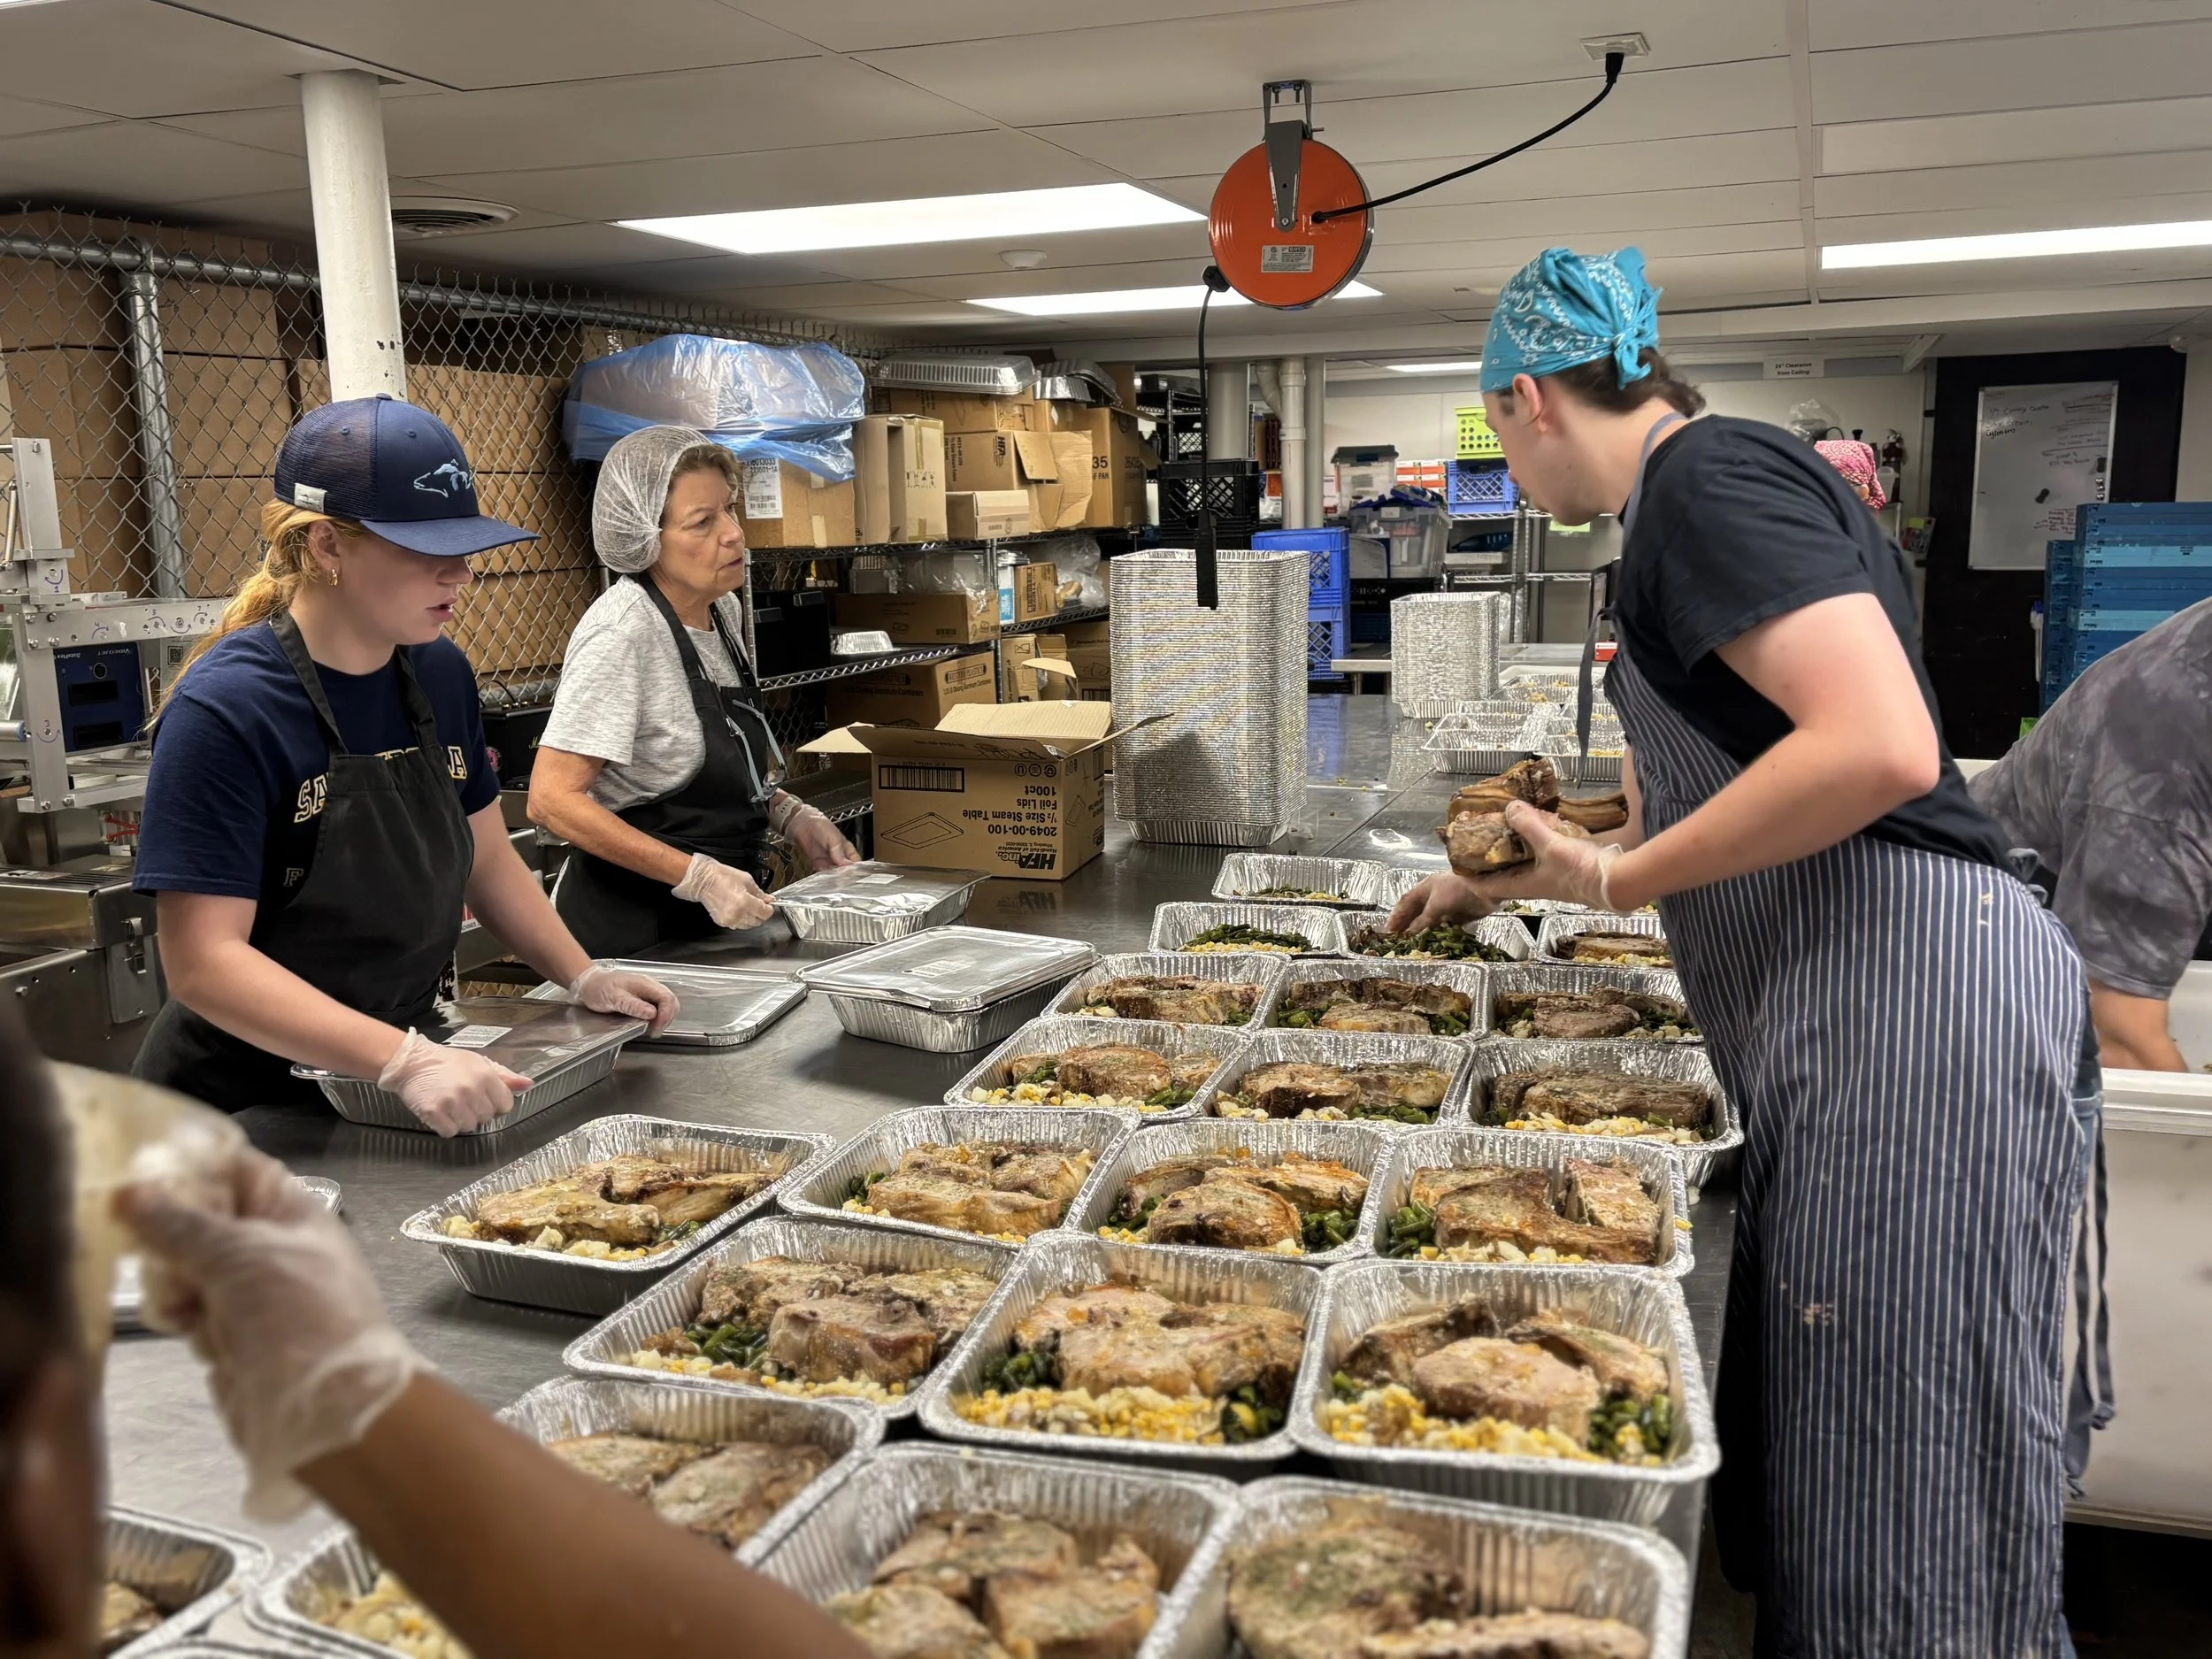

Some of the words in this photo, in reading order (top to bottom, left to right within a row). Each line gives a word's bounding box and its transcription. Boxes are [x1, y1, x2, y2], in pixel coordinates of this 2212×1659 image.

[997, 436, 1006, 456] HFA
[1025, 785, 1056, 797] 100ct
[1017, 798, 1037, 810] Lids
[1040, 800, 1057, 810] Foil
[963, 809, 989, 821] Table
[992, 810, 1023, 822] Steam
[1025, 812, 1046, 824] Size
[988, 825, 1057, 837] 2049-00-100
